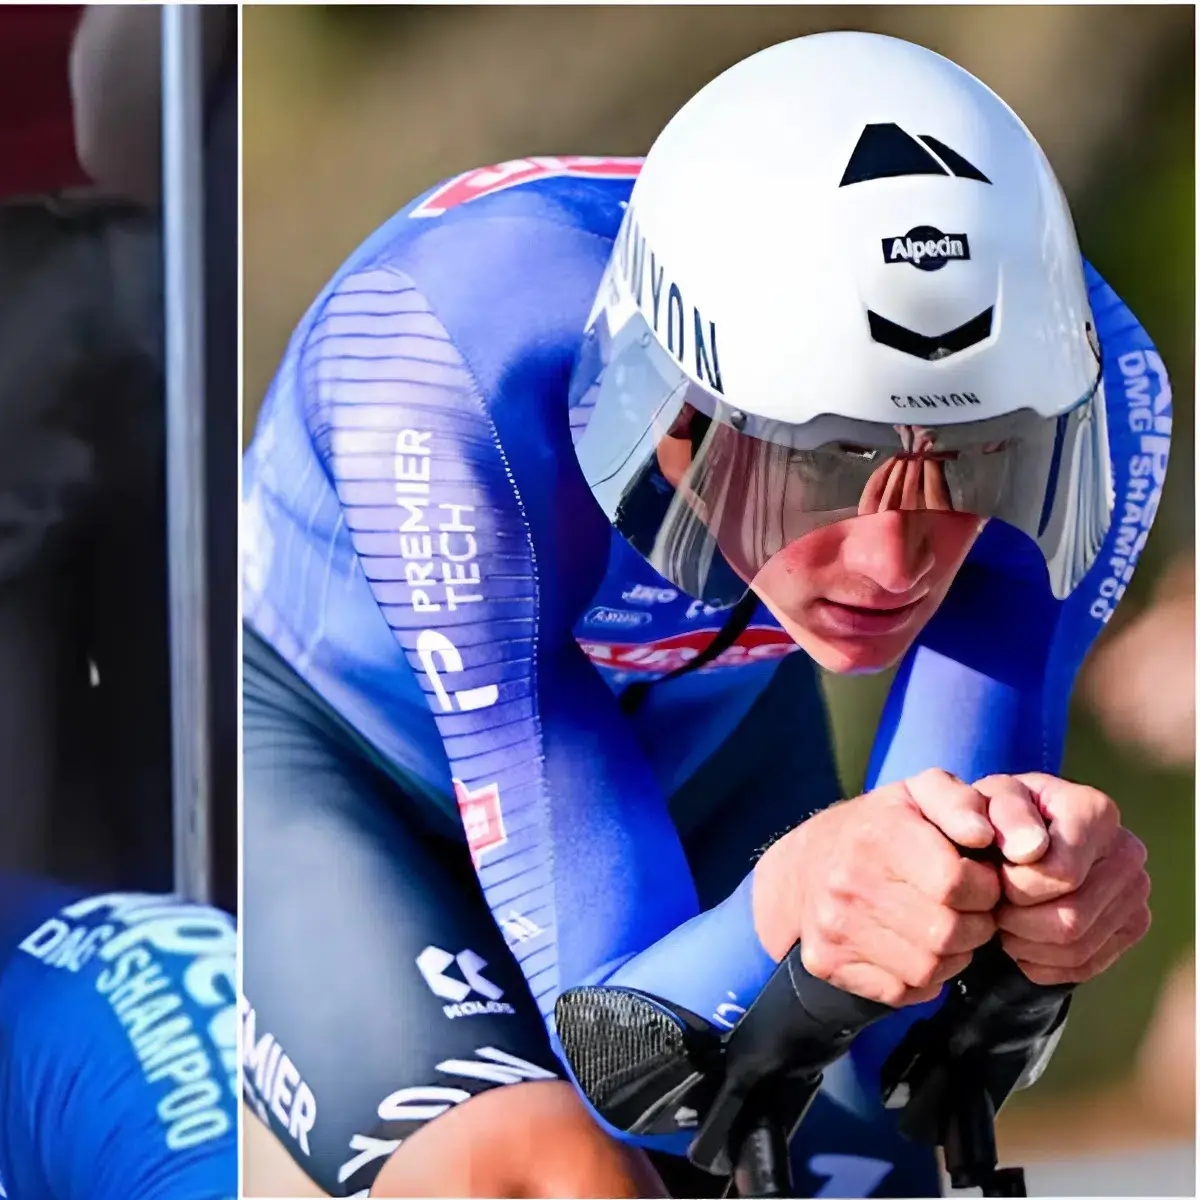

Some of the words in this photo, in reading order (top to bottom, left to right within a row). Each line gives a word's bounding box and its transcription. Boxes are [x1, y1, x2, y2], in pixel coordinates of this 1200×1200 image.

[890, 236, 964, 264] Alpecin
[890, 392, 981, 408] CANYON
[1118, 351, 1152, 433] DMG
[395, 428, 441, 613] PREMIER
[439, 502, 484, 611] TECH
[1090, 455, 1150, 622] SHAMPOO
[95, 947, 230, 1151] SHAMPOO
[243, 995, 317, 1157] MIER
[338, 1047, 558, 1197] YON
